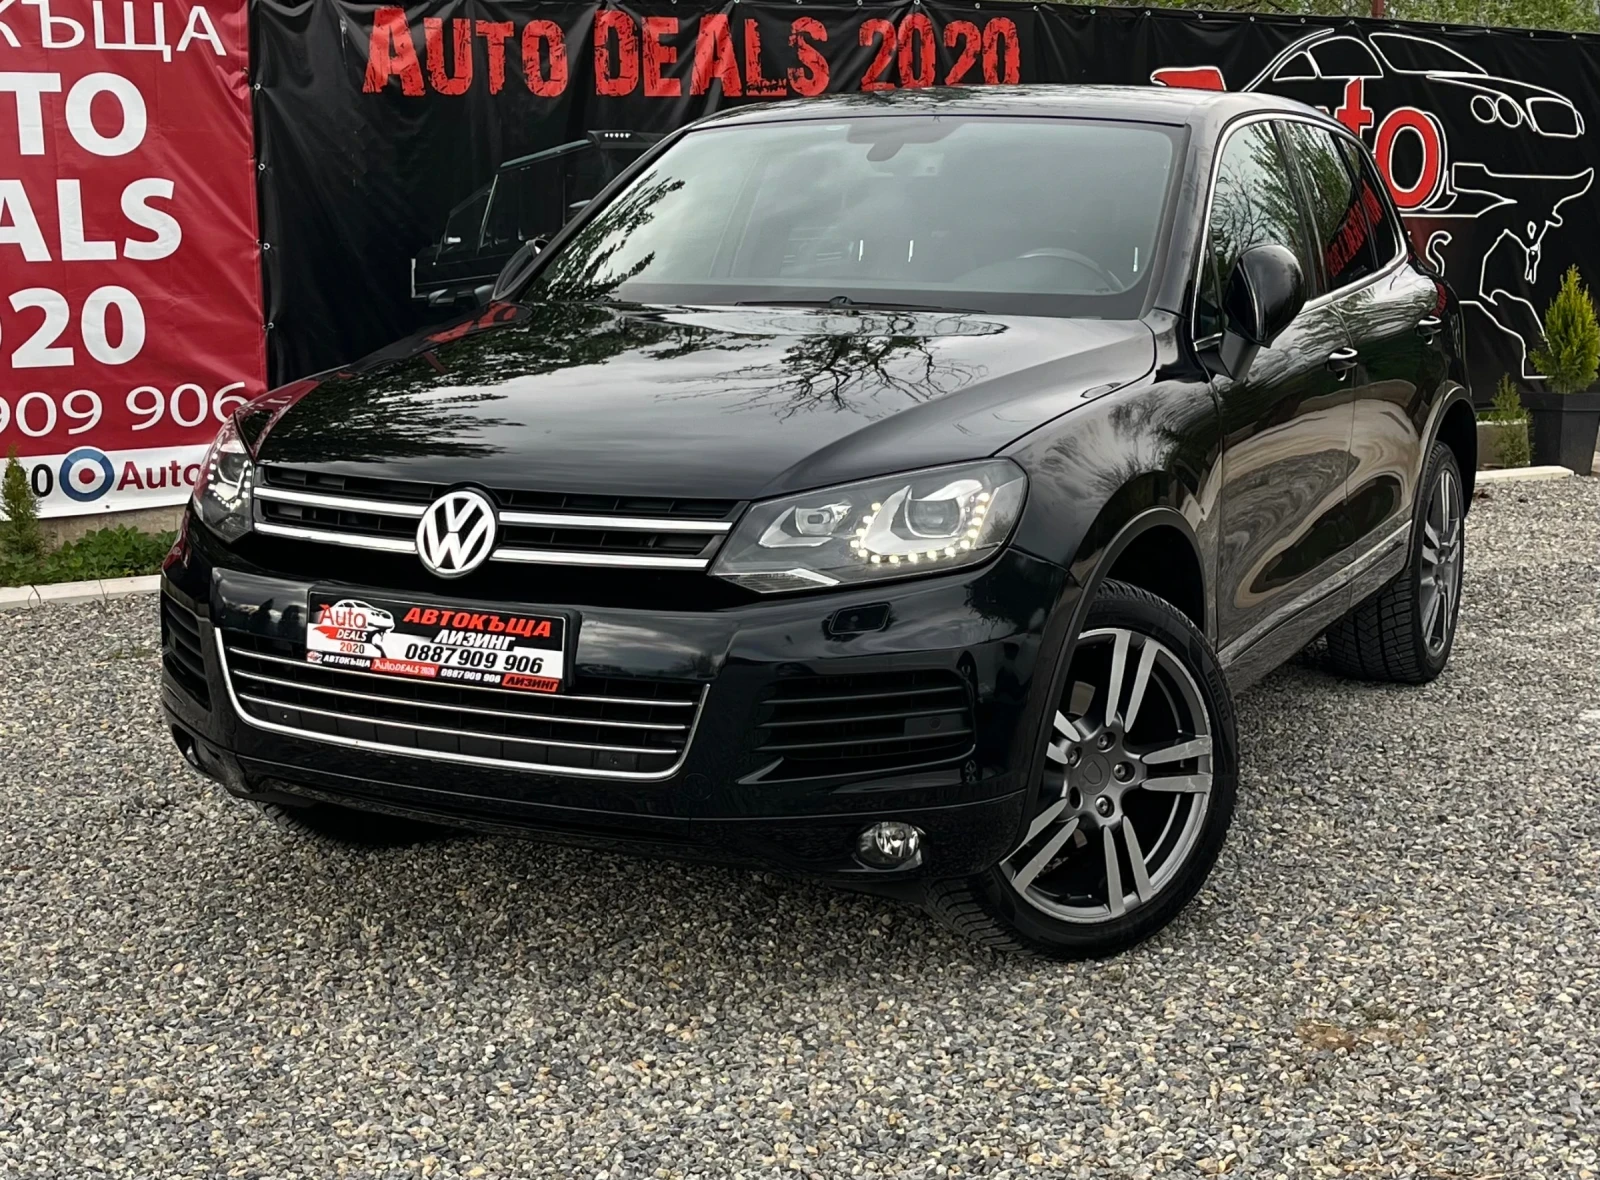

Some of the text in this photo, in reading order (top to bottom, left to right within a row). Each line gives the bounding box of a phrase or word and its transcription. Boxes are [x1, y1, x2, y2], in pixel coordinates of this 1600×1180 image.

[361, 5, 1020, 97] AUTO DEALS 2020
[0, 285, 146, 368] 20
[0, 382, 246, 437] 09 906
[403, 607, 552, 637] АВТОКЪЩА
[336, 629, 369, 642] DEALS
[433, 629, 517, 650] ЛИЗИНГ
[323, 655, 371, 667] АВТОКЪЩА
[340, 642, 366, 655] 2020
[405, 643, 545, 674] 0887 909 906
[505, 676, 559, 691] ЛИЗИНГ
